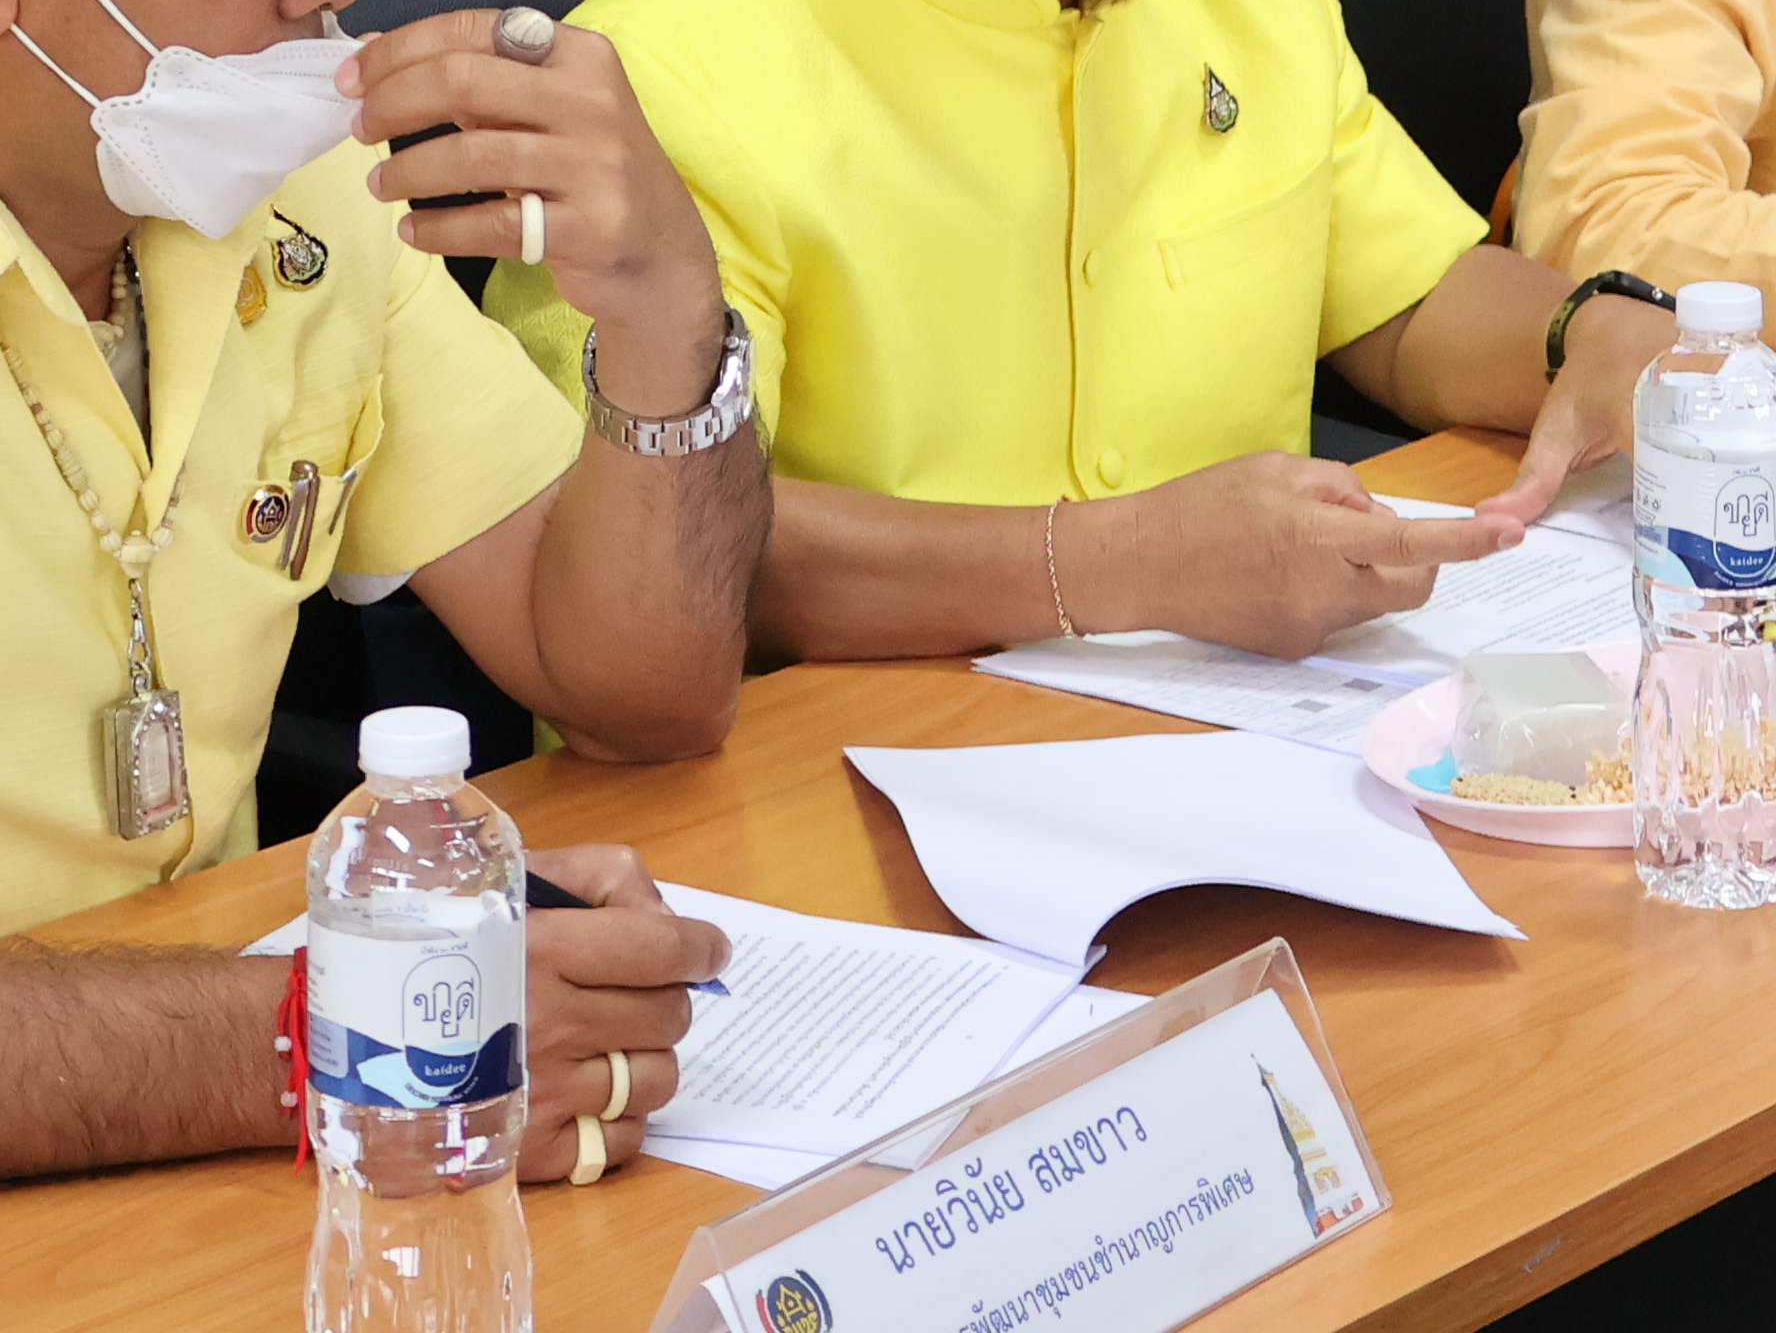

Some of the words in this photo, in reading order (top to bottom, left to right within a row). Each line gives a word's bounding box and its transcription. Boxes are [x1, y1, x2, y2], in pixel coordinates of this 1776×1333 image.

[875, 1156, 1026, 1274] นายวินัย
[1028, 1105, 1148, 1194] สมขาว
[958, 1167, 1255, 1333] พัฒนาชุมชนชำนาญการพิเศษ
